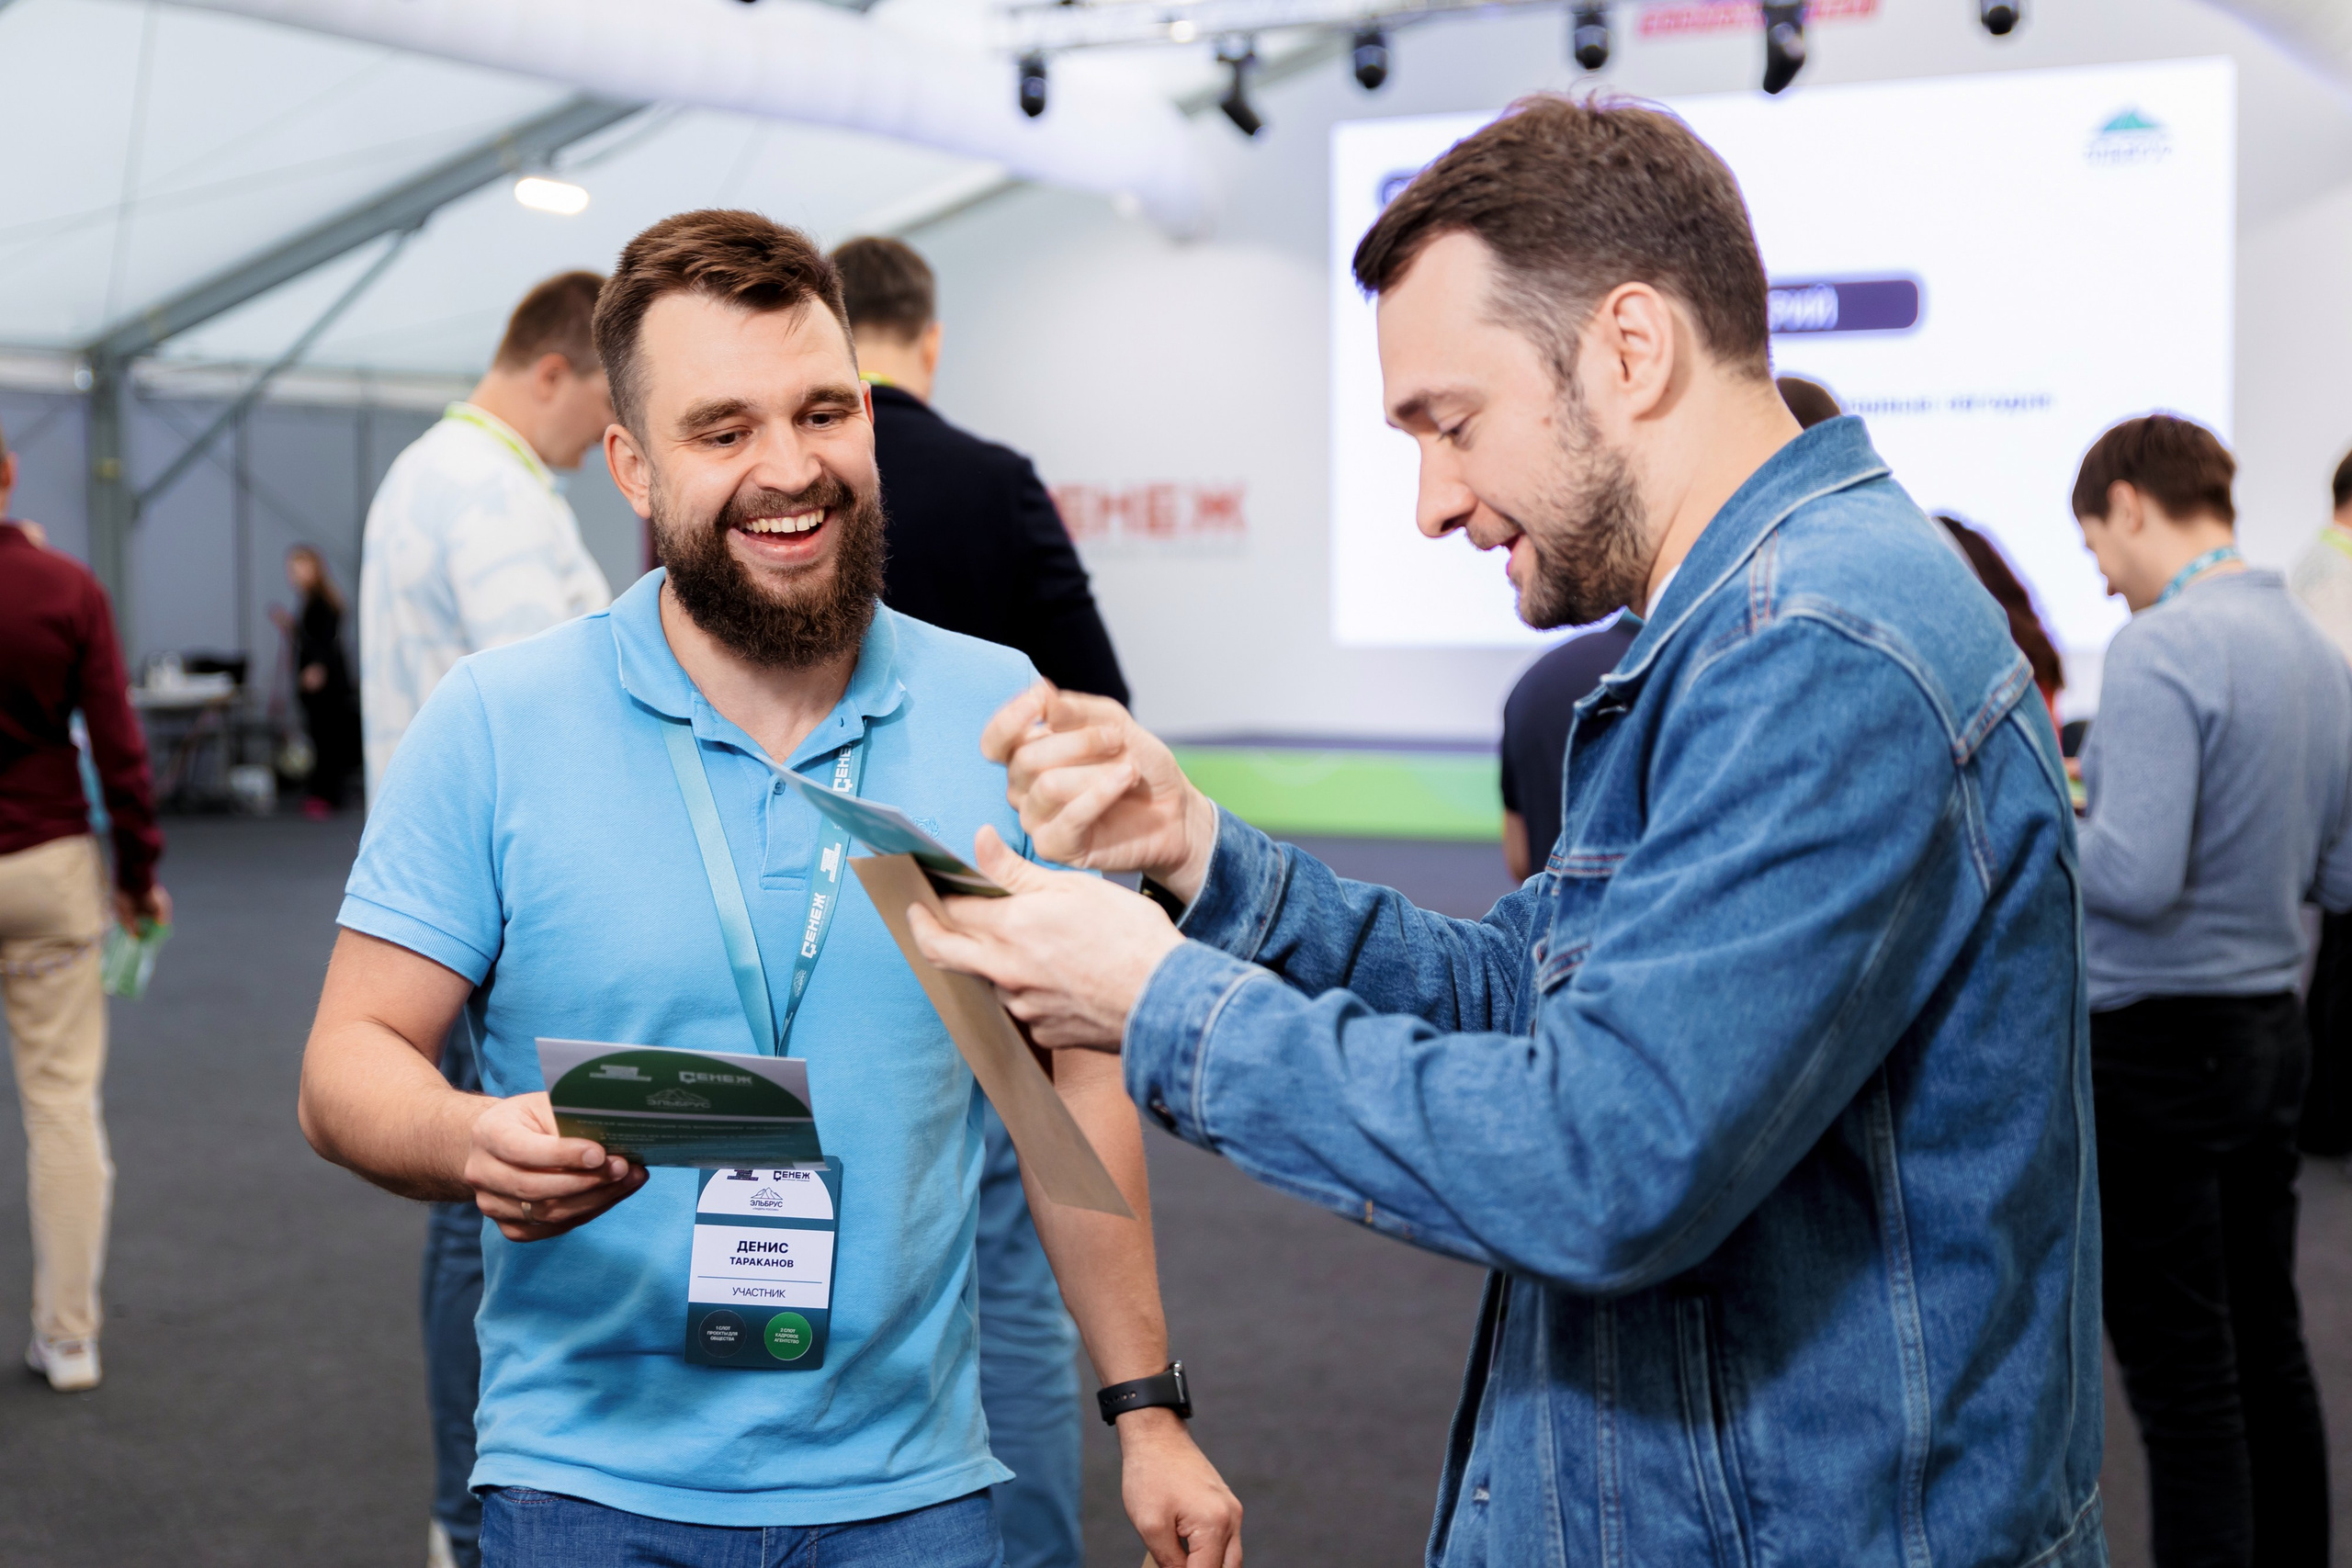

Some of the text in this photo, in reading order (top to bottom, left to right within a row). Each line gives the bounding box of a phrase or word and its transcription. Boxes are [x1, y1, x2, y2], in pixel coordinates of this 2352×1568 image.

[1051, 482, 1247, 540] ЕНЕЖ
[750, 1200, 783, 1208] ЭЛЬБРУС
[736, 1240, 789, 1254] ДЕНИС
[729, 1257, 794, 1268] ТАРАКАНОВ
[732, 1287, 786, 1298] УЧАСТНИК
